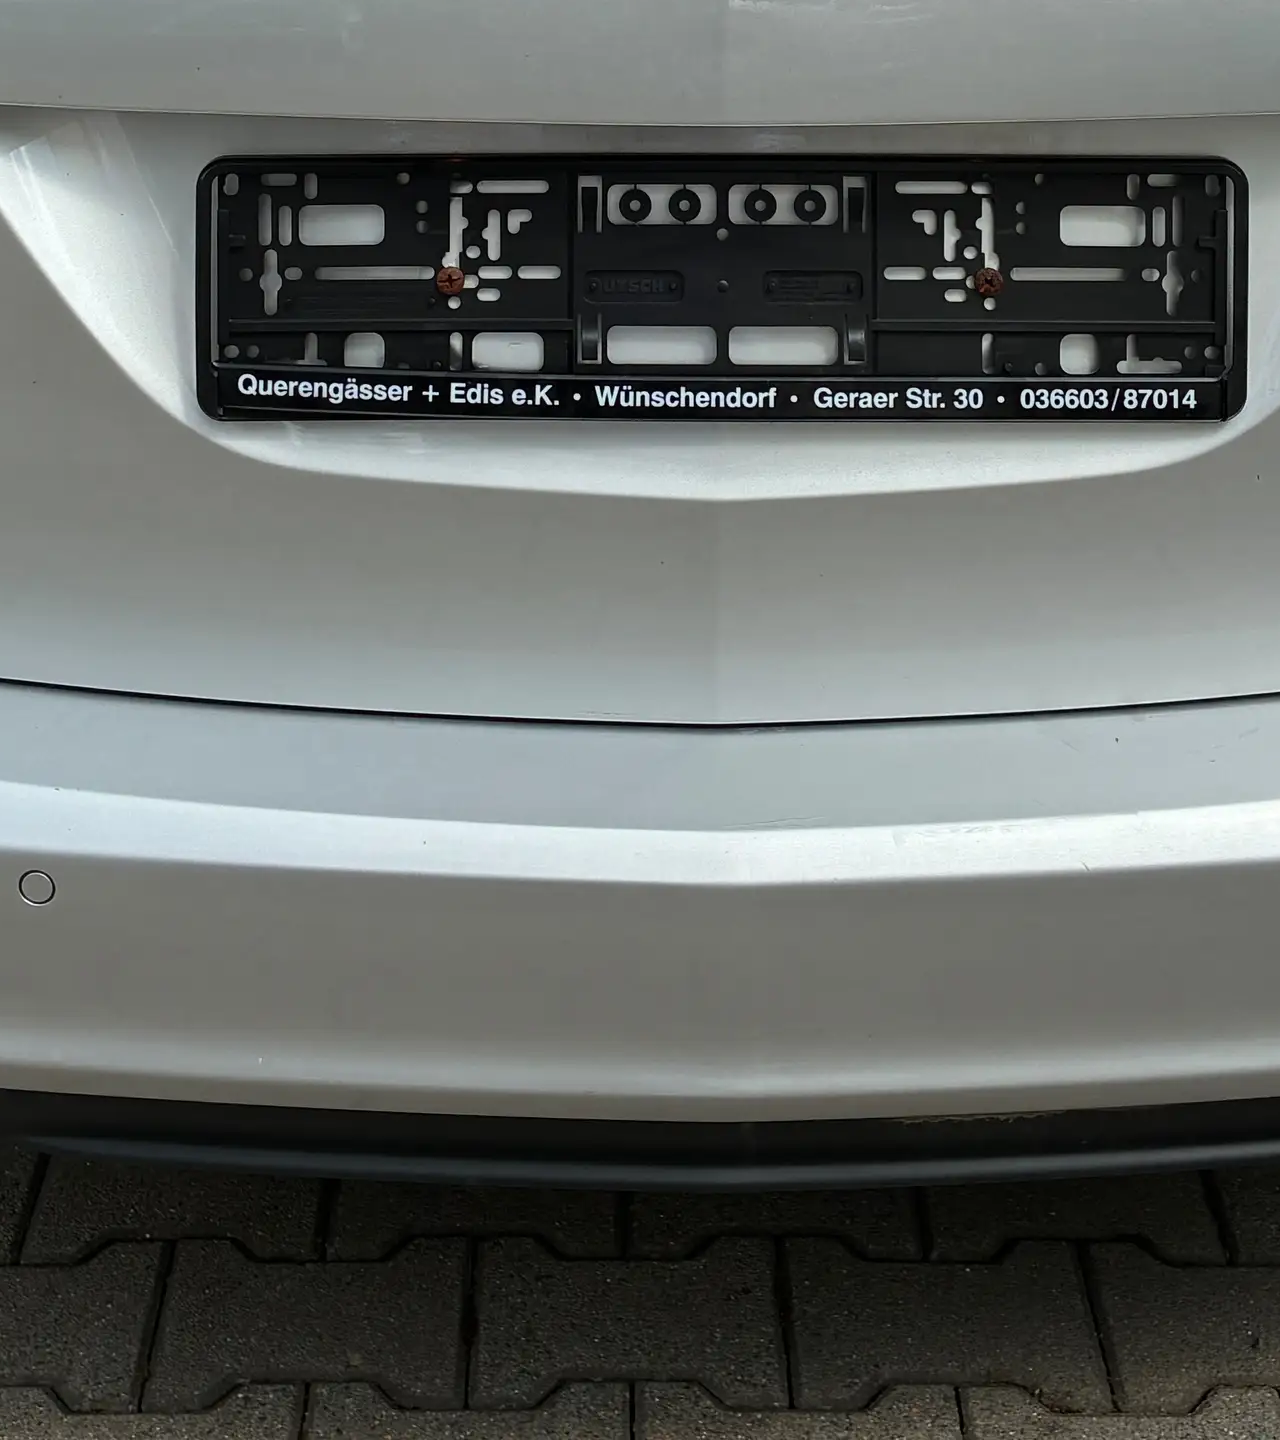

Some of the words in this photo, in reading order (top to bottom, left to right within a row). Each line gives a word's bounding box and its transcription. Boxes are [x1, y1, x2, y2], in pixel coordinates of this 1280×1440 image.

[237, 373, 413, 404] Querengässer
[422, 384, 439, 403] +
[450, 383, 504, 404] Edis
[511, 384, 560, 406] e.K.
[595, 385, 777, 408] Wünschendorf
[813, 387, 899, 409] Geraer
[905, 387, 946, 409] Str.
[953, 388, 984, 409] 30
[1020, 388, 1197, 411] 036603/87014
